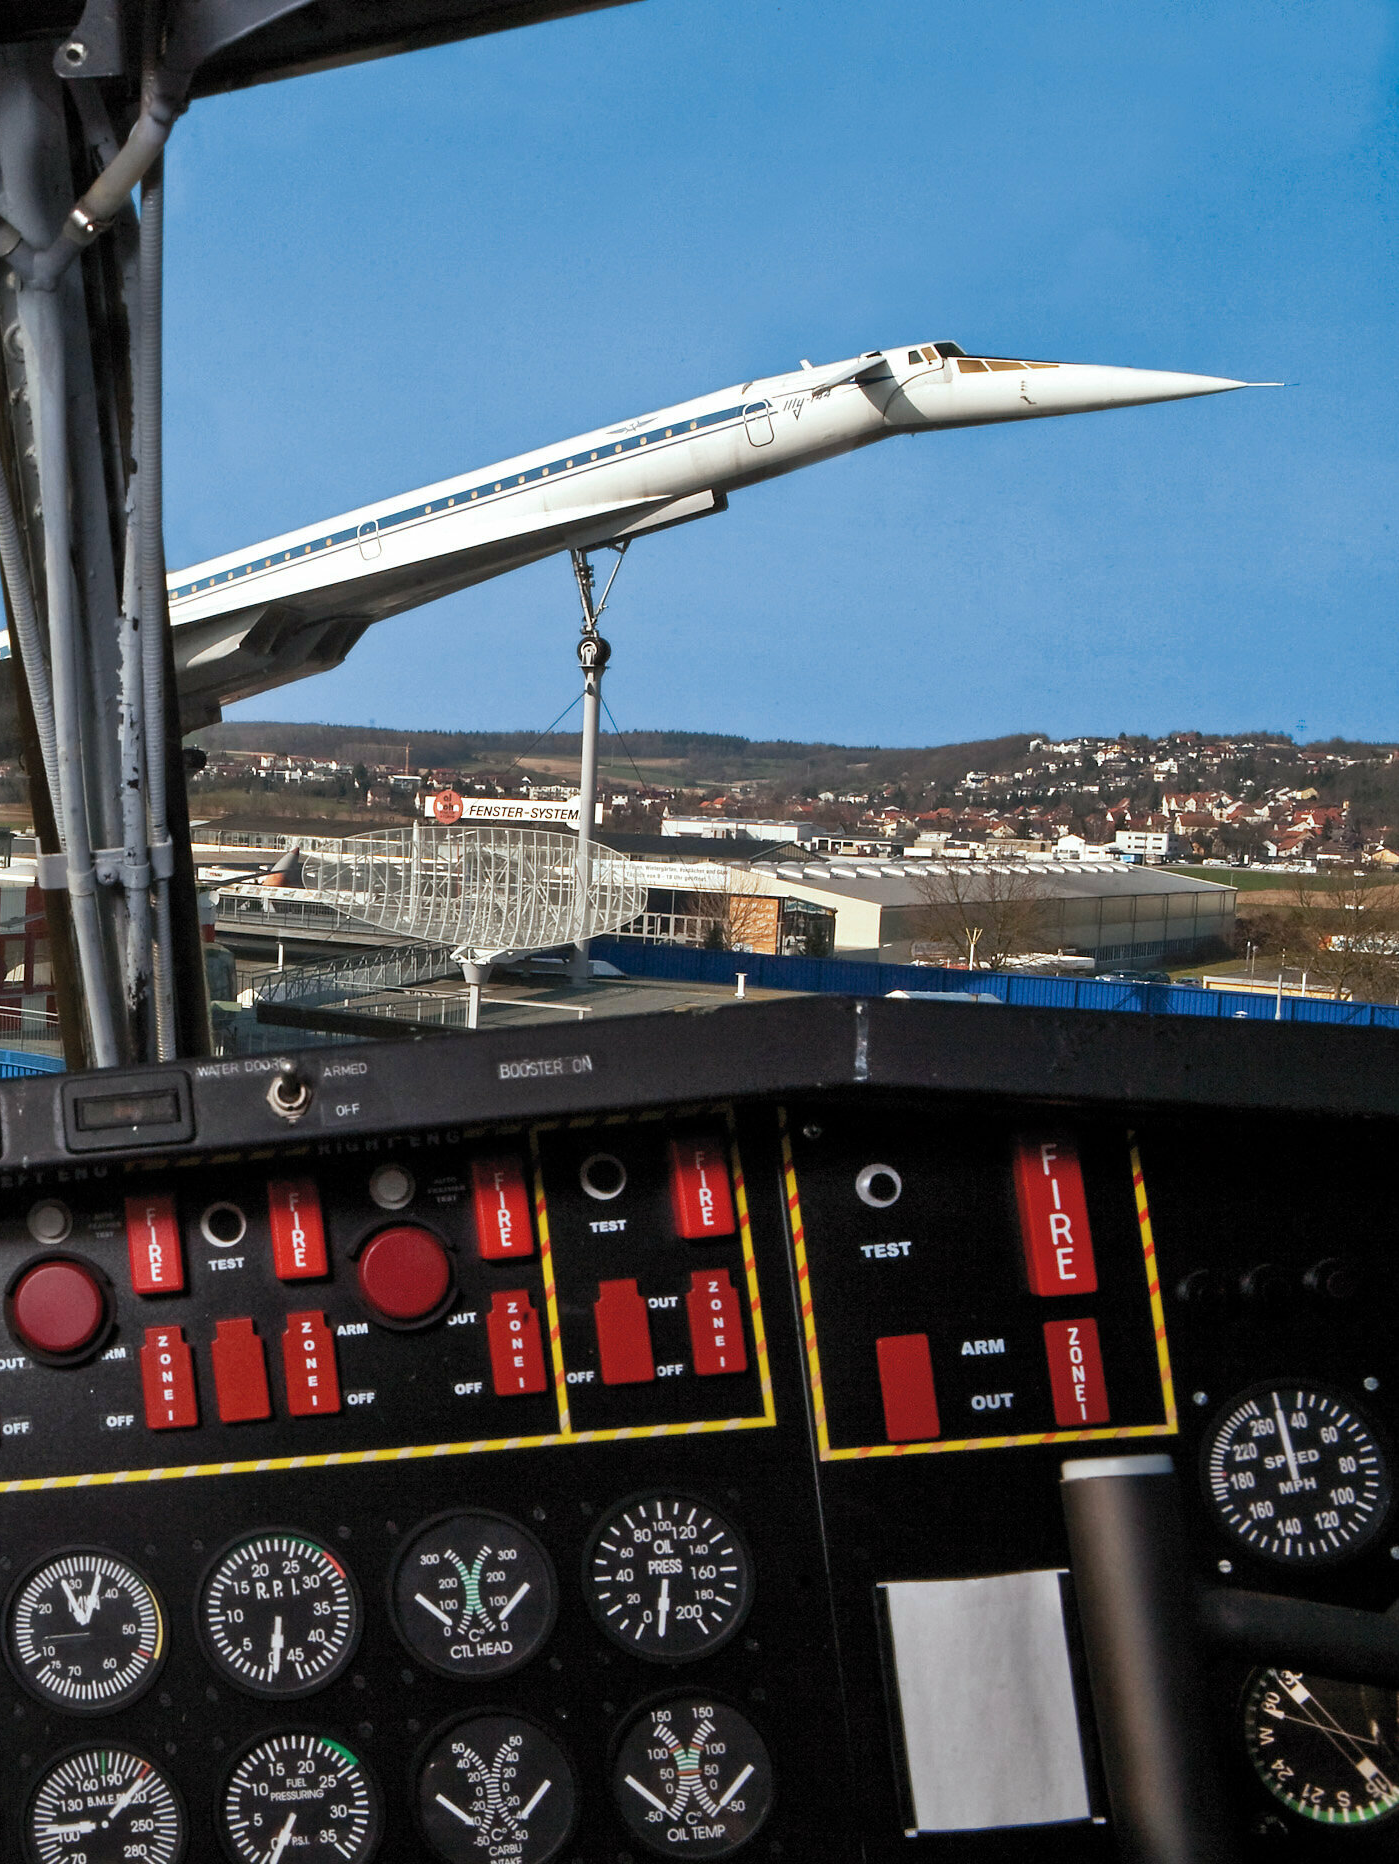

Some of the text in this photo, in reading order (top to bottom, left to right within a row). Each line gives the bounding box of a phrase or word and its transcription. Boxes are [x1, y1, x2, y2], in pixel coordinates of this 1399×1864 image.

[469, 805, 581, 820] FENSTER-SYSTEM
[323, 1062, 368, 1077] ARMED
[499, 1054, 592, 1080] BOOSTER ON
[336, 1103, 360, 1116] OFF
[695, 1151, 714, 1226] FIRE
[494, 1172, 512, 1247] FIRE
[1040, 1142, 1077, 1281] FIRE
[289, 1193, 306, 1267] FIRE
[589, 1220, 626, 1233] TEST
[145, 1207, 163, 1283] FIRE
[860, 1241, 911, 1259] TEST
[208, 1257, 244, 1271] TEST
[648, 1296, 678, 1309] OUT
[336, 1322, 368, 1337] ARM
[102, 1348, 126, 1360] RM
[961, 1339, 1005, 1356] ARM
[567, 1371, 595, 1383] OFF
[656, 1364, 683, 1377] OFF
[454, 1382, 482, 1395] OFF
[347, 1392, 375, 1405] OFF
[971, 1393, 1014, 1410] OUT
[3, 1422, 30, 1435] OFF
[106, 1415, 134, 1428] OFF
[1249, 1418, 1275, 1437] 260
[1264, 1449, 1320, 1469] SPEED
[1279, 1478, 1317, 1495] MPH
[672, 1525, 697, 1540] 120
[1277, 1518, 1301, 1536] 140
[654, 1540, 674, 1554] OIL
[420, 1554, 439, 1565] 300
[498, 1550, 517, 1560] 300
[282, 1560, 300, 1574] 25
[648, 1559, 682, 1575] PRESS
[314, 1602, 331, 1615] 35
[676, 1605, 702, 1619] 200
[122, 1624, 136, 1634] 50
[287, 1648, 304, 1661] 45
[450, 1641, 513, 1658] CTL HEAD
[651, 1710, 672, 1723] 150
[692, 1706, 713, 1718] 150
[76, 1779, 98, 1792] 160
[286, 1778, 307, 1788] FUEL
[319, 1775, 337, 1789] 25
[270, 1789, 324, 1801] PRESSURING
[330, 1805, 347, 1818] 30
[131, 1819, 154, 1833] 250
[667, 1825, 725, 1842] OIL TEMP
[489, 1843, 522, 1856] CARBU
